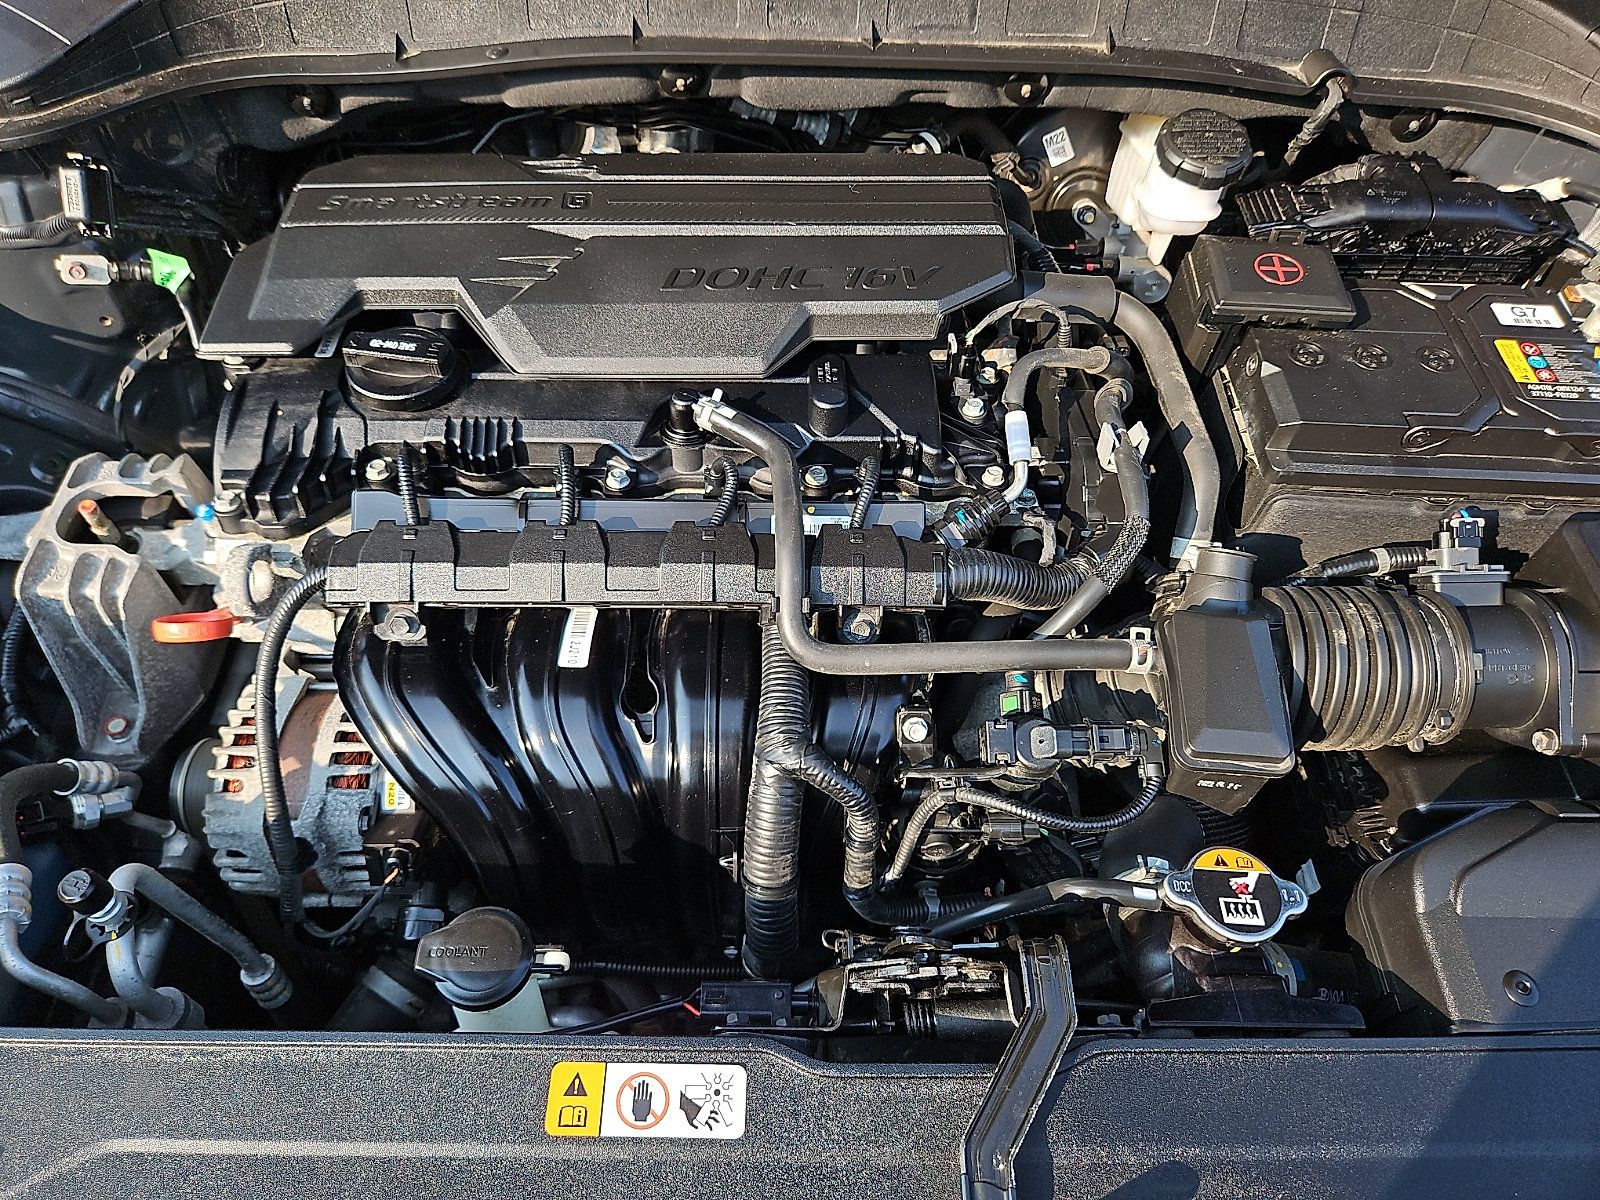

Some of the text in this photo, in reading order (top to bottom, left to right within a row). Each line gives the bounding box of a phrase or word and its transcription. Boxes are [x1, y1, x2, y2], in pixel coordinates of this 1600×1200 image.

[1045, 130, 1067, 149] M22
[318, 193, 554, 211] Smartstream
[659, 265, 943, 291] DOHC 16V
[1510, 306, 1537, 318] G7
[388, 782, 396, 805] N20
[428, 944, 490, 958] COOLANT
